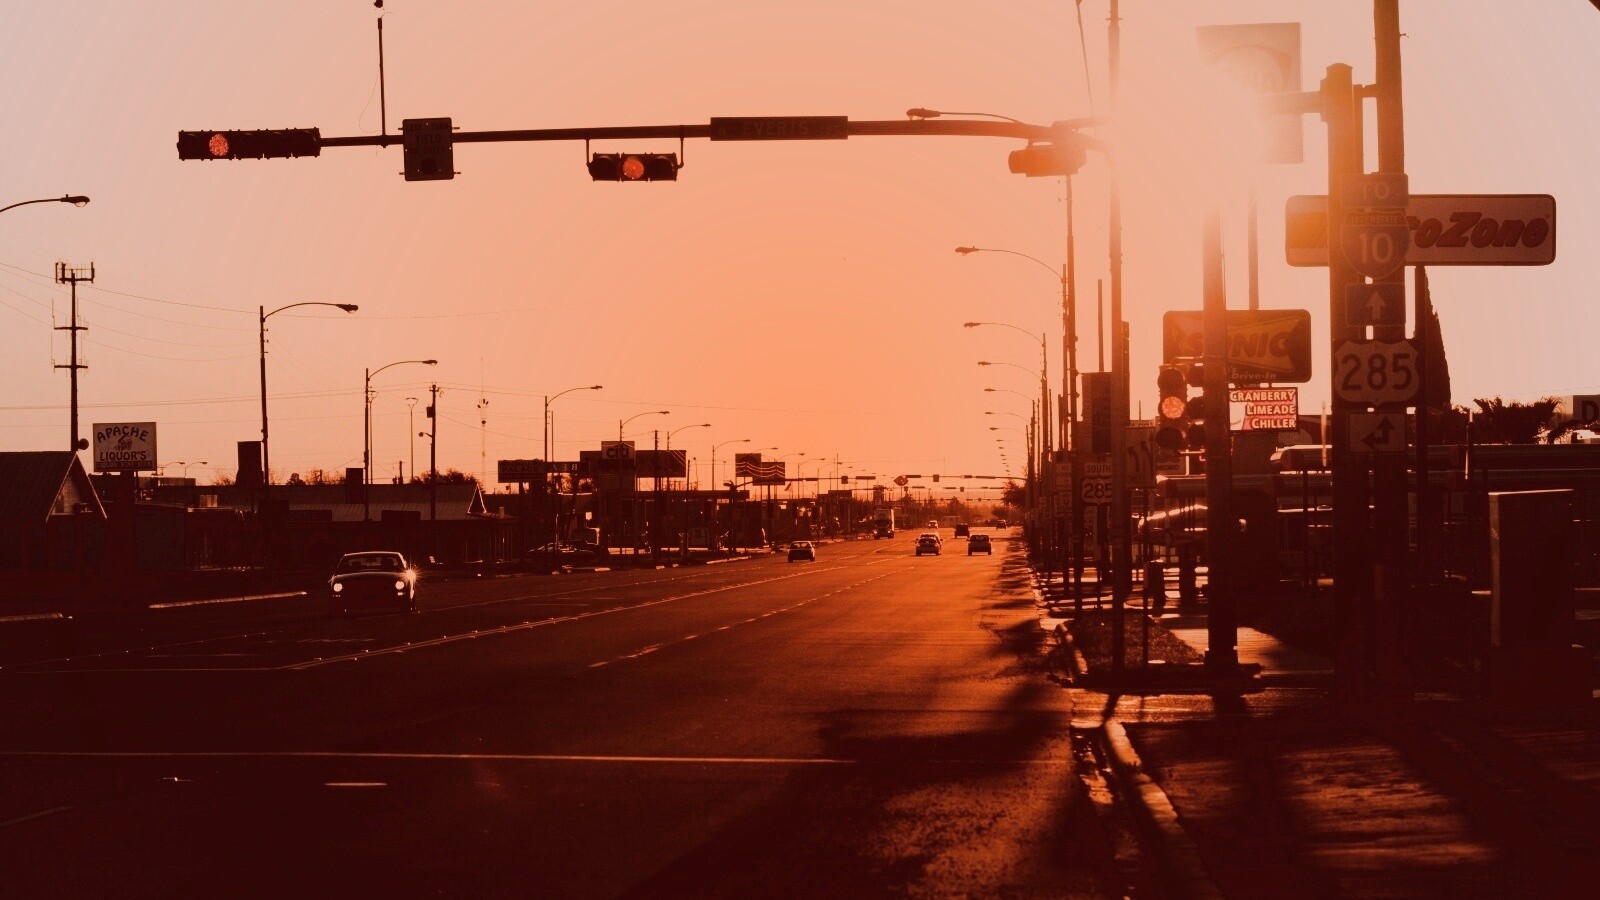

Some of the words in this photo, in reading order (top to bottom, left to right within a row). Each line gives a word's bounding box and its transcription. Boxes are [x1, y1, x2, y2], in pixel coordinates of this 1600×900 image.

[743, 120, 809, 136] EVERTS
[415, 133, 442, 145] YIELD
[1360, 181, 1390, 200] TO
[1359, 232, 1393, 264] 10
[1183, 332, 1292, 358] SNIC
[1341, 353, 1411, 390] 285
[1229, 390, 1296, 402] CRANBERRY
[1246, 405, 1296, 416] LIMEADE
[1251, 418, 1297, 429] CHILLER
[97, 425, 149, 443] APACHE
[100, 450, 147, 461] LIQUOR'S
[1086, 464, 1111, 473] SOUTH
[1083, 482, 1112, 499] 285
